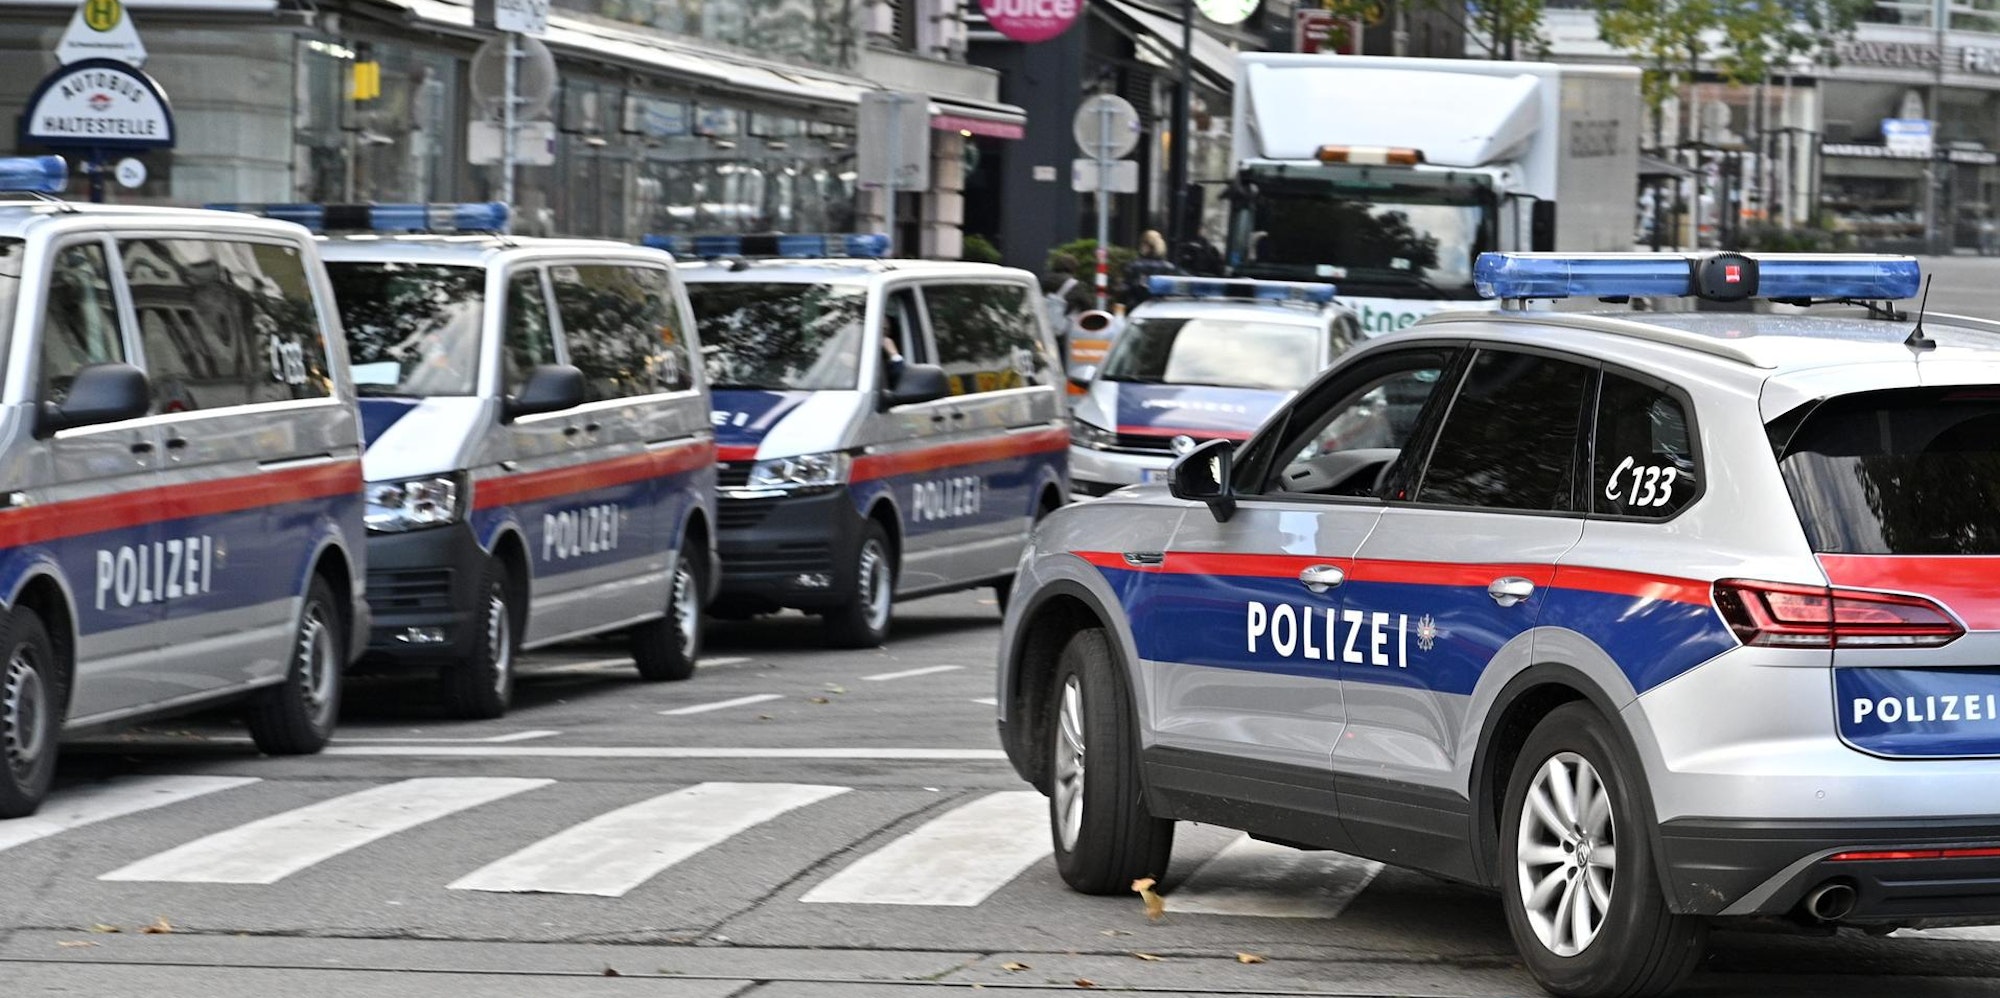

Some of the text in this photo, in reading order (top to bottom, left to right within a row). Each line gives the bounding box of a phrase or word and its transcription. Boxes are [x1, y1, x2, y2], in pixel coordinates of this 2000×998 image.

[93, 0, 114, 24] H
[984, 0, 1077, 19] Juice
[60, 73, 144, 103] AUTOBUS
[43, 116, 157, 136] HALTESTELLE
[912, 474, 980, 523] POLIZEI
[1628, 465, 1677, 507] 133
[542, 503, 619, 562] POLIZEI
[95, 534, 212, 611] POLIZEI
[1247, 600, 1408, 668] POLIZEI
[1853, 694, 1997, 724] POLIZEI
